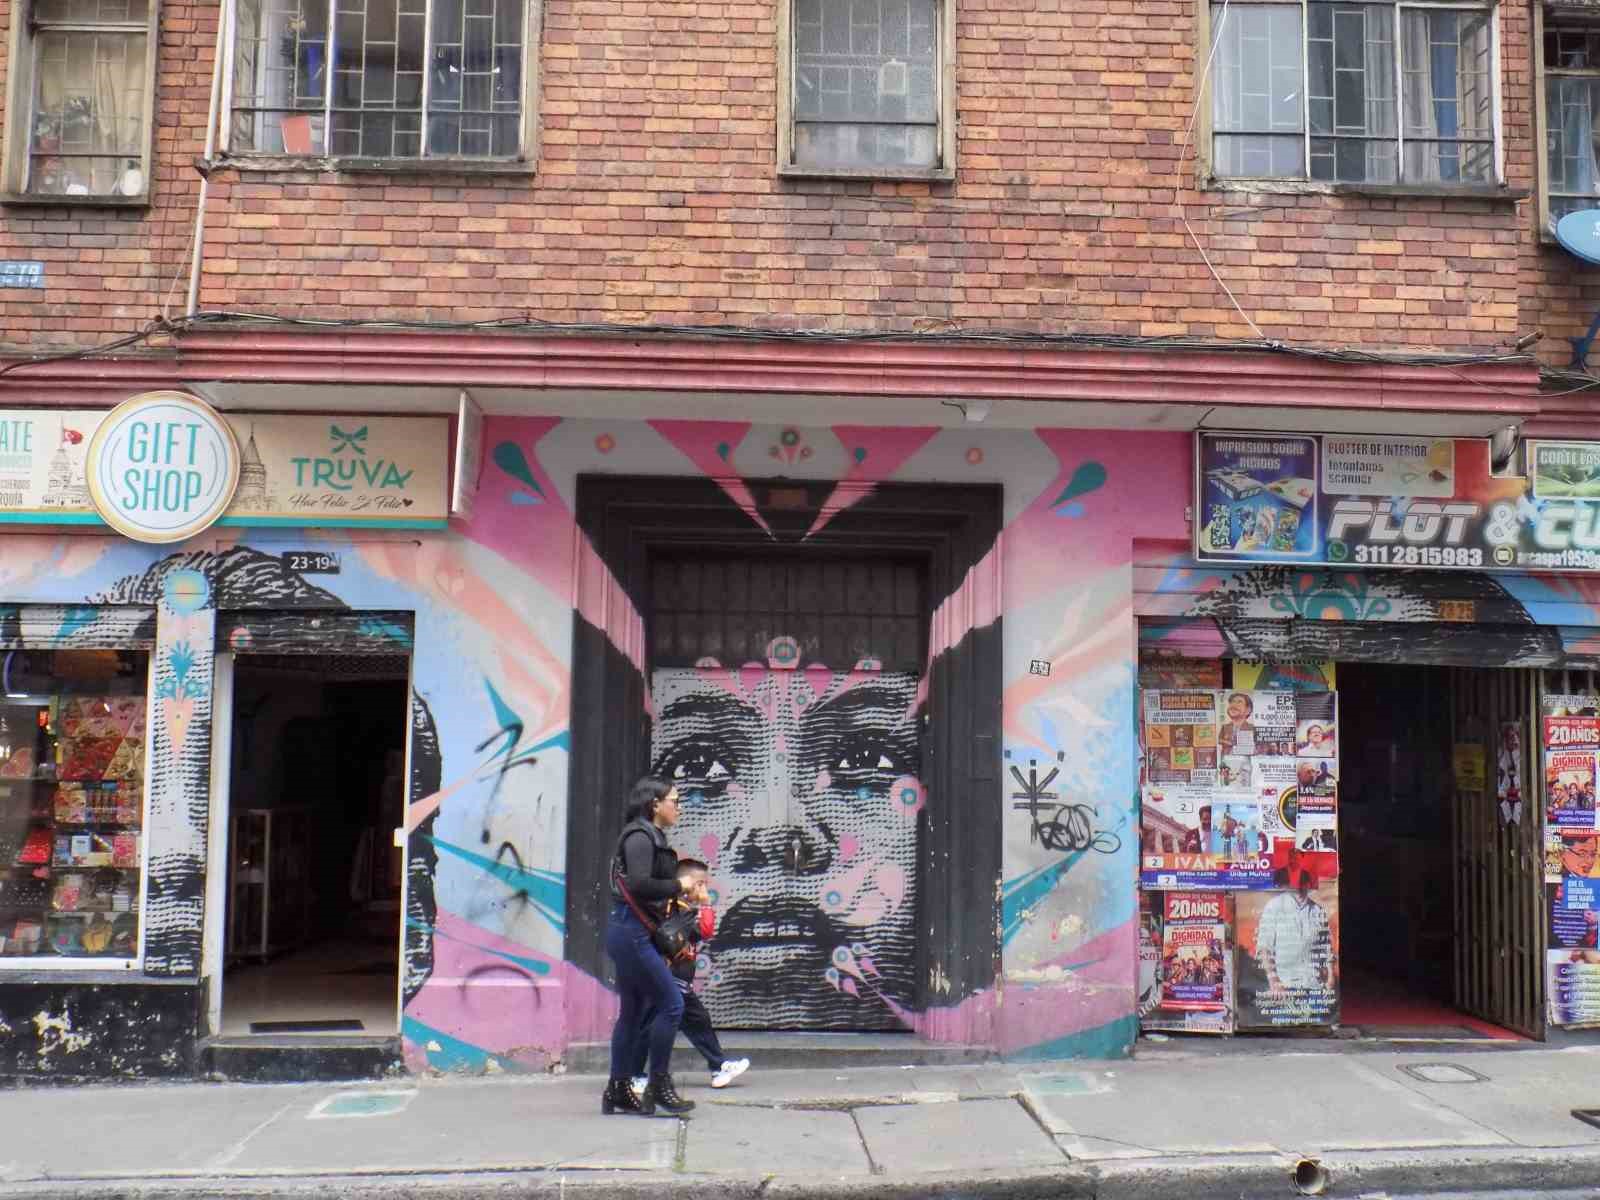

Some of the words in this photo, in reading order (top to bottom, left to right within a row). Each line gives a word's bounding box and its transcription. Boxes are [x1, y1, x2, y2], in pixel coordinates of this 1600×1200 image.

[128, 421, 202, 465] GIFT
[1328, 442, 1368, 454] PLOTTER
[1370, 444, 1381, 456] DE
[1384, 443, 1427, 457] INTERIOR
[289, 457, 415, 491] TRUVA
[122, 468, 202, 513] SHOP
[1327, 500, 1482, 544] PLOT
[1484, 504, 1521, 545] &
[290, 556, 331, 570] 23-19
[1355, 545, 1389, 563] 311
[1392, 546, 1483, 566] 2815983
[1548, 726, 1570, 745] 20
[1570, 726, 1600, 744] AÑOS
[1552, 756, 1595, 768] DIGNIDAD
[1174, 855, 1217, 870] IVÁN
[1169, 900, 1190, 919] 20
[1190, 899, 1220, 917] AÑOS
[1171, 930, 1214, 942] DIGNIDAD
